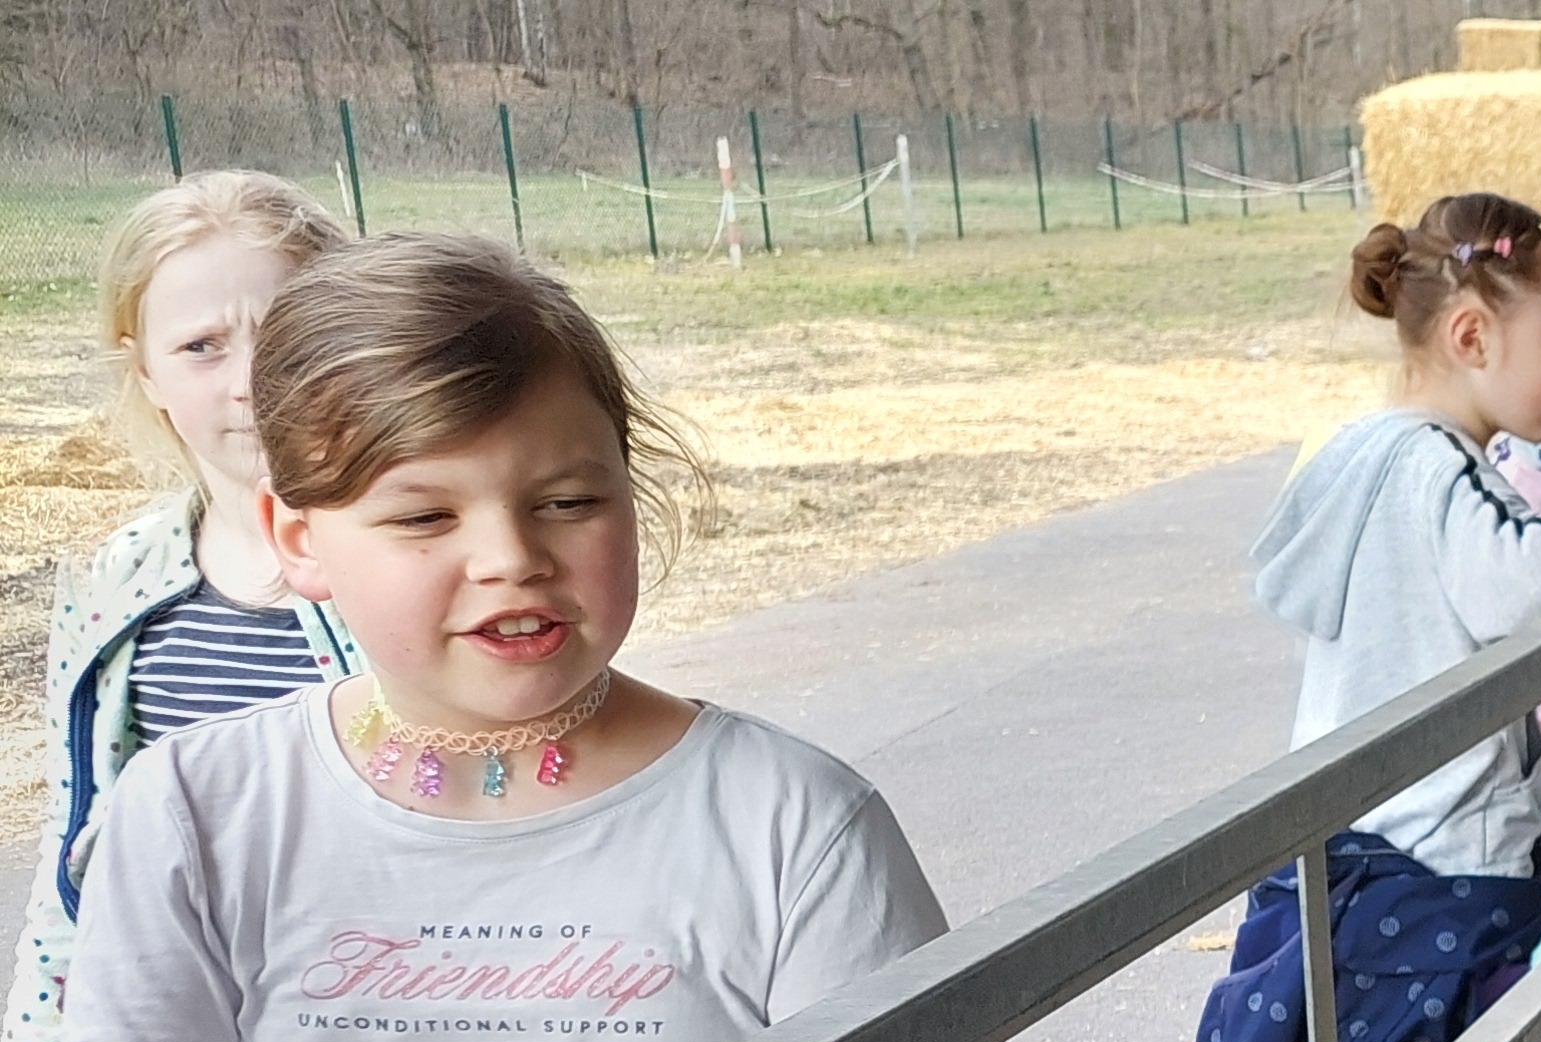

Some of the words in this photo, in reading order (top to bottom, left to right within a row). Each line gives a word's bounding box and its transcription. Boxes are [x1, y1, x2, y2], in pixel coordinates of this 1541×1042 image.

[419, 924, 543, 939] MEANING
[560, 924, 592, 939] OF
[301, 930, 675, 1017] Friendship
[298, 1013, 527, 1033] UNCONDITIONAL
[543, 1020, 664, 1035] SUPPORT
